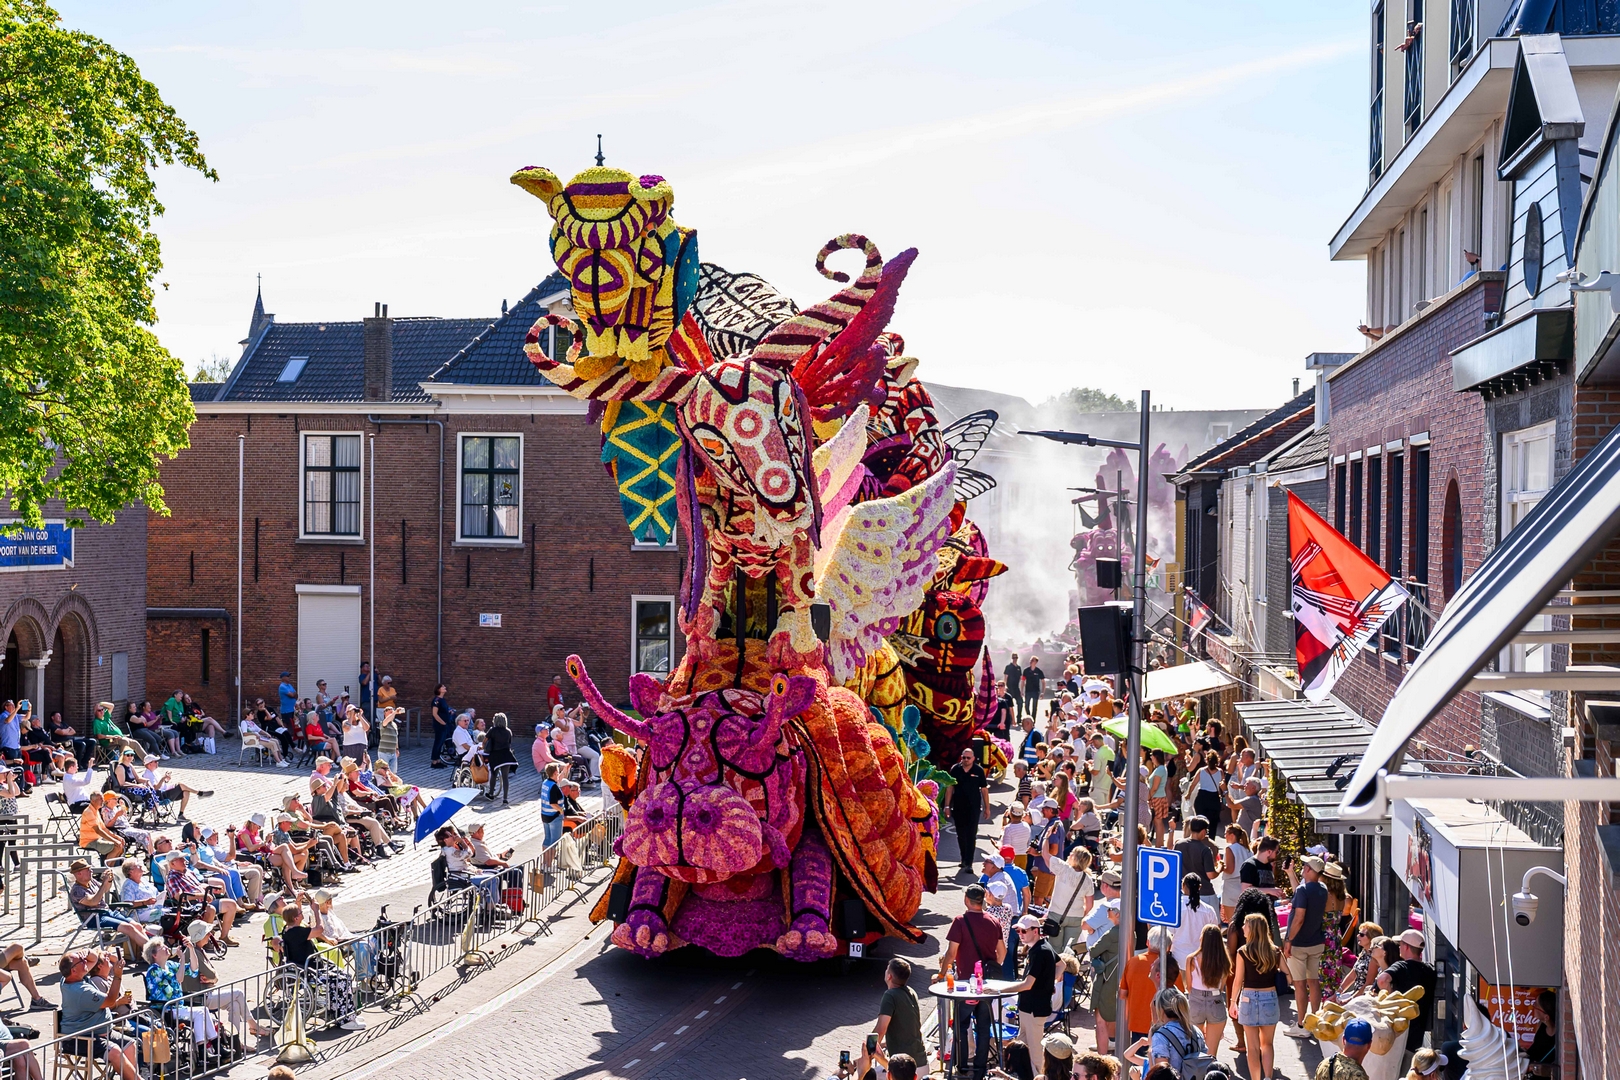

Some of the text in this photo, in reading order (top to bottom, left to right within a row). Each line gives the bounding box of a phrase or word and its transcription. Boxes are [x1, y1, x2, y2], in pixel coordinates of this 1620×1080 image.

[24, 531, 34, 541] VAN
[36, 531, 49, 541] GOD
[18, 546, 29, 555] VAN
[30, 545, 38, 555] DE
[39, 545, 58, 555] HEMEL
[1148, 855, 1170, 891] P
[851, 944, 861, 953] 10
